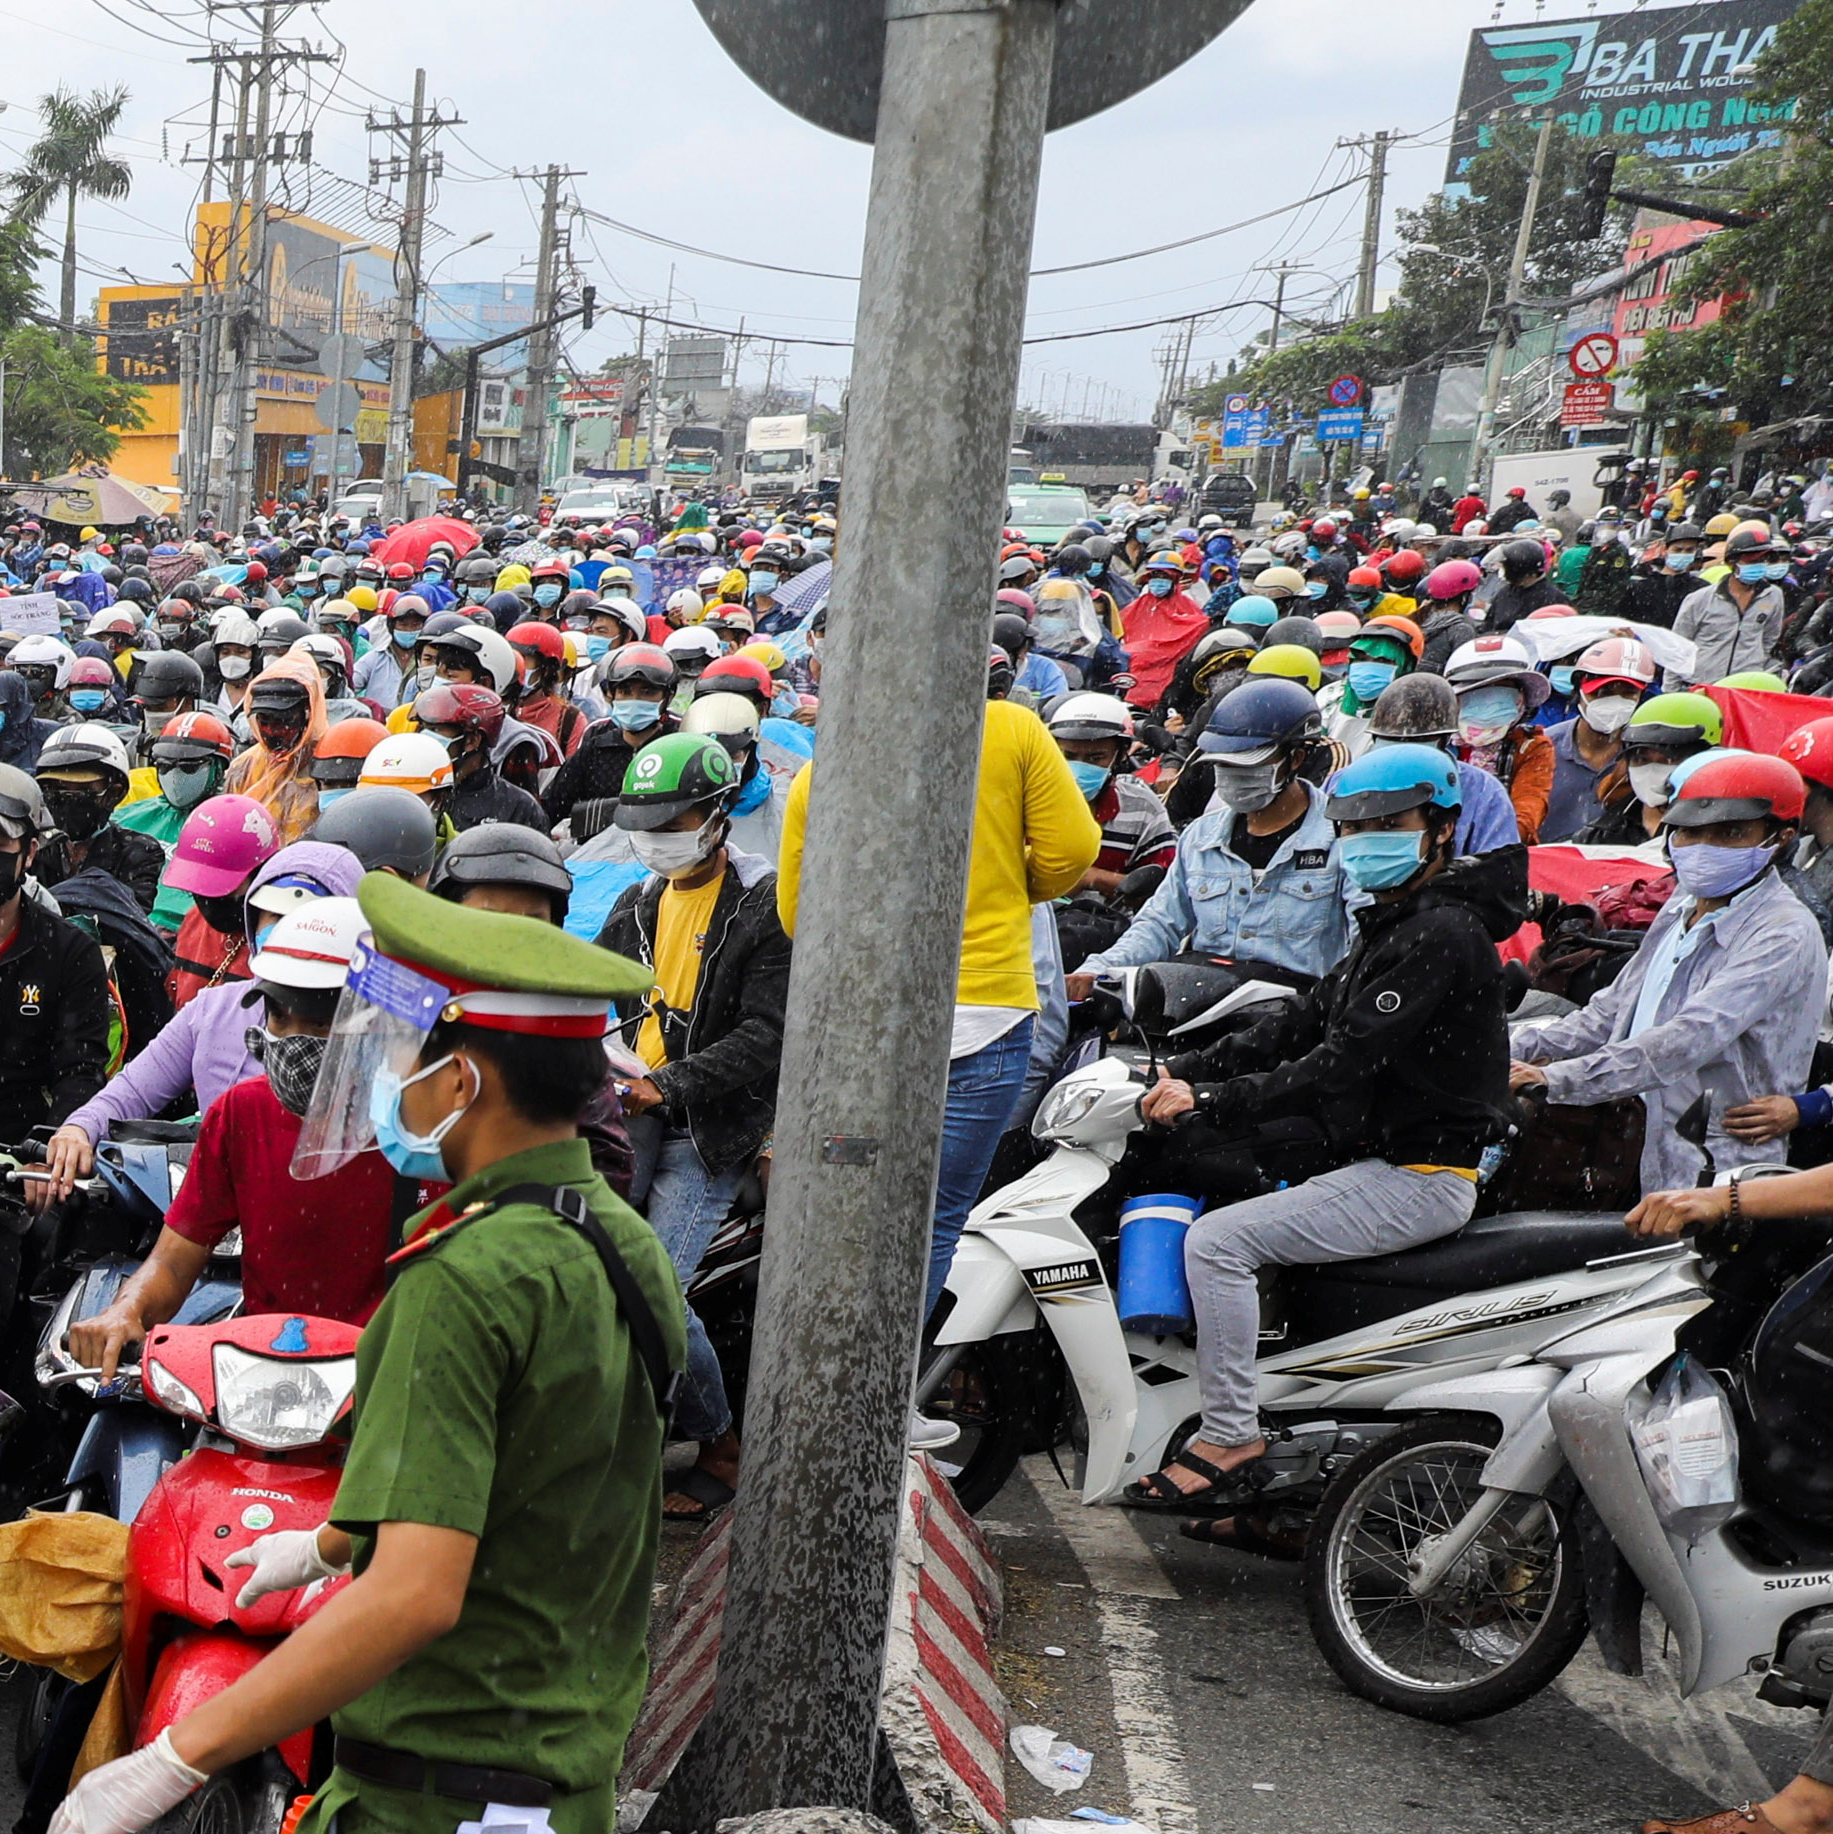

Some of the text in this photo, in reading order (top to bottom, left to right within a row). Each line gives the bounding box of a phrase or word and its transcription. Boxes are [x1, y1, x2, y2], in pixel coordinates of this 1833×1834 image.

[1584, 25, 1779, 87] BA THA
[1580, 79, 1694, 100] INDUSTRIAL
[1613, 101, 1710, 134] CÔNG
[633, 781, 656, 792] gojek
[1299, 855, 1324, 866] HBA
[1033, 1263, 1090, 1286] YAMAHA
[1393, 1289, 1558, 1336] SIRIUS
[231, 1486, 295, 1504] HONDA
[1763, 1574, 1832, 1592] SUZUK
